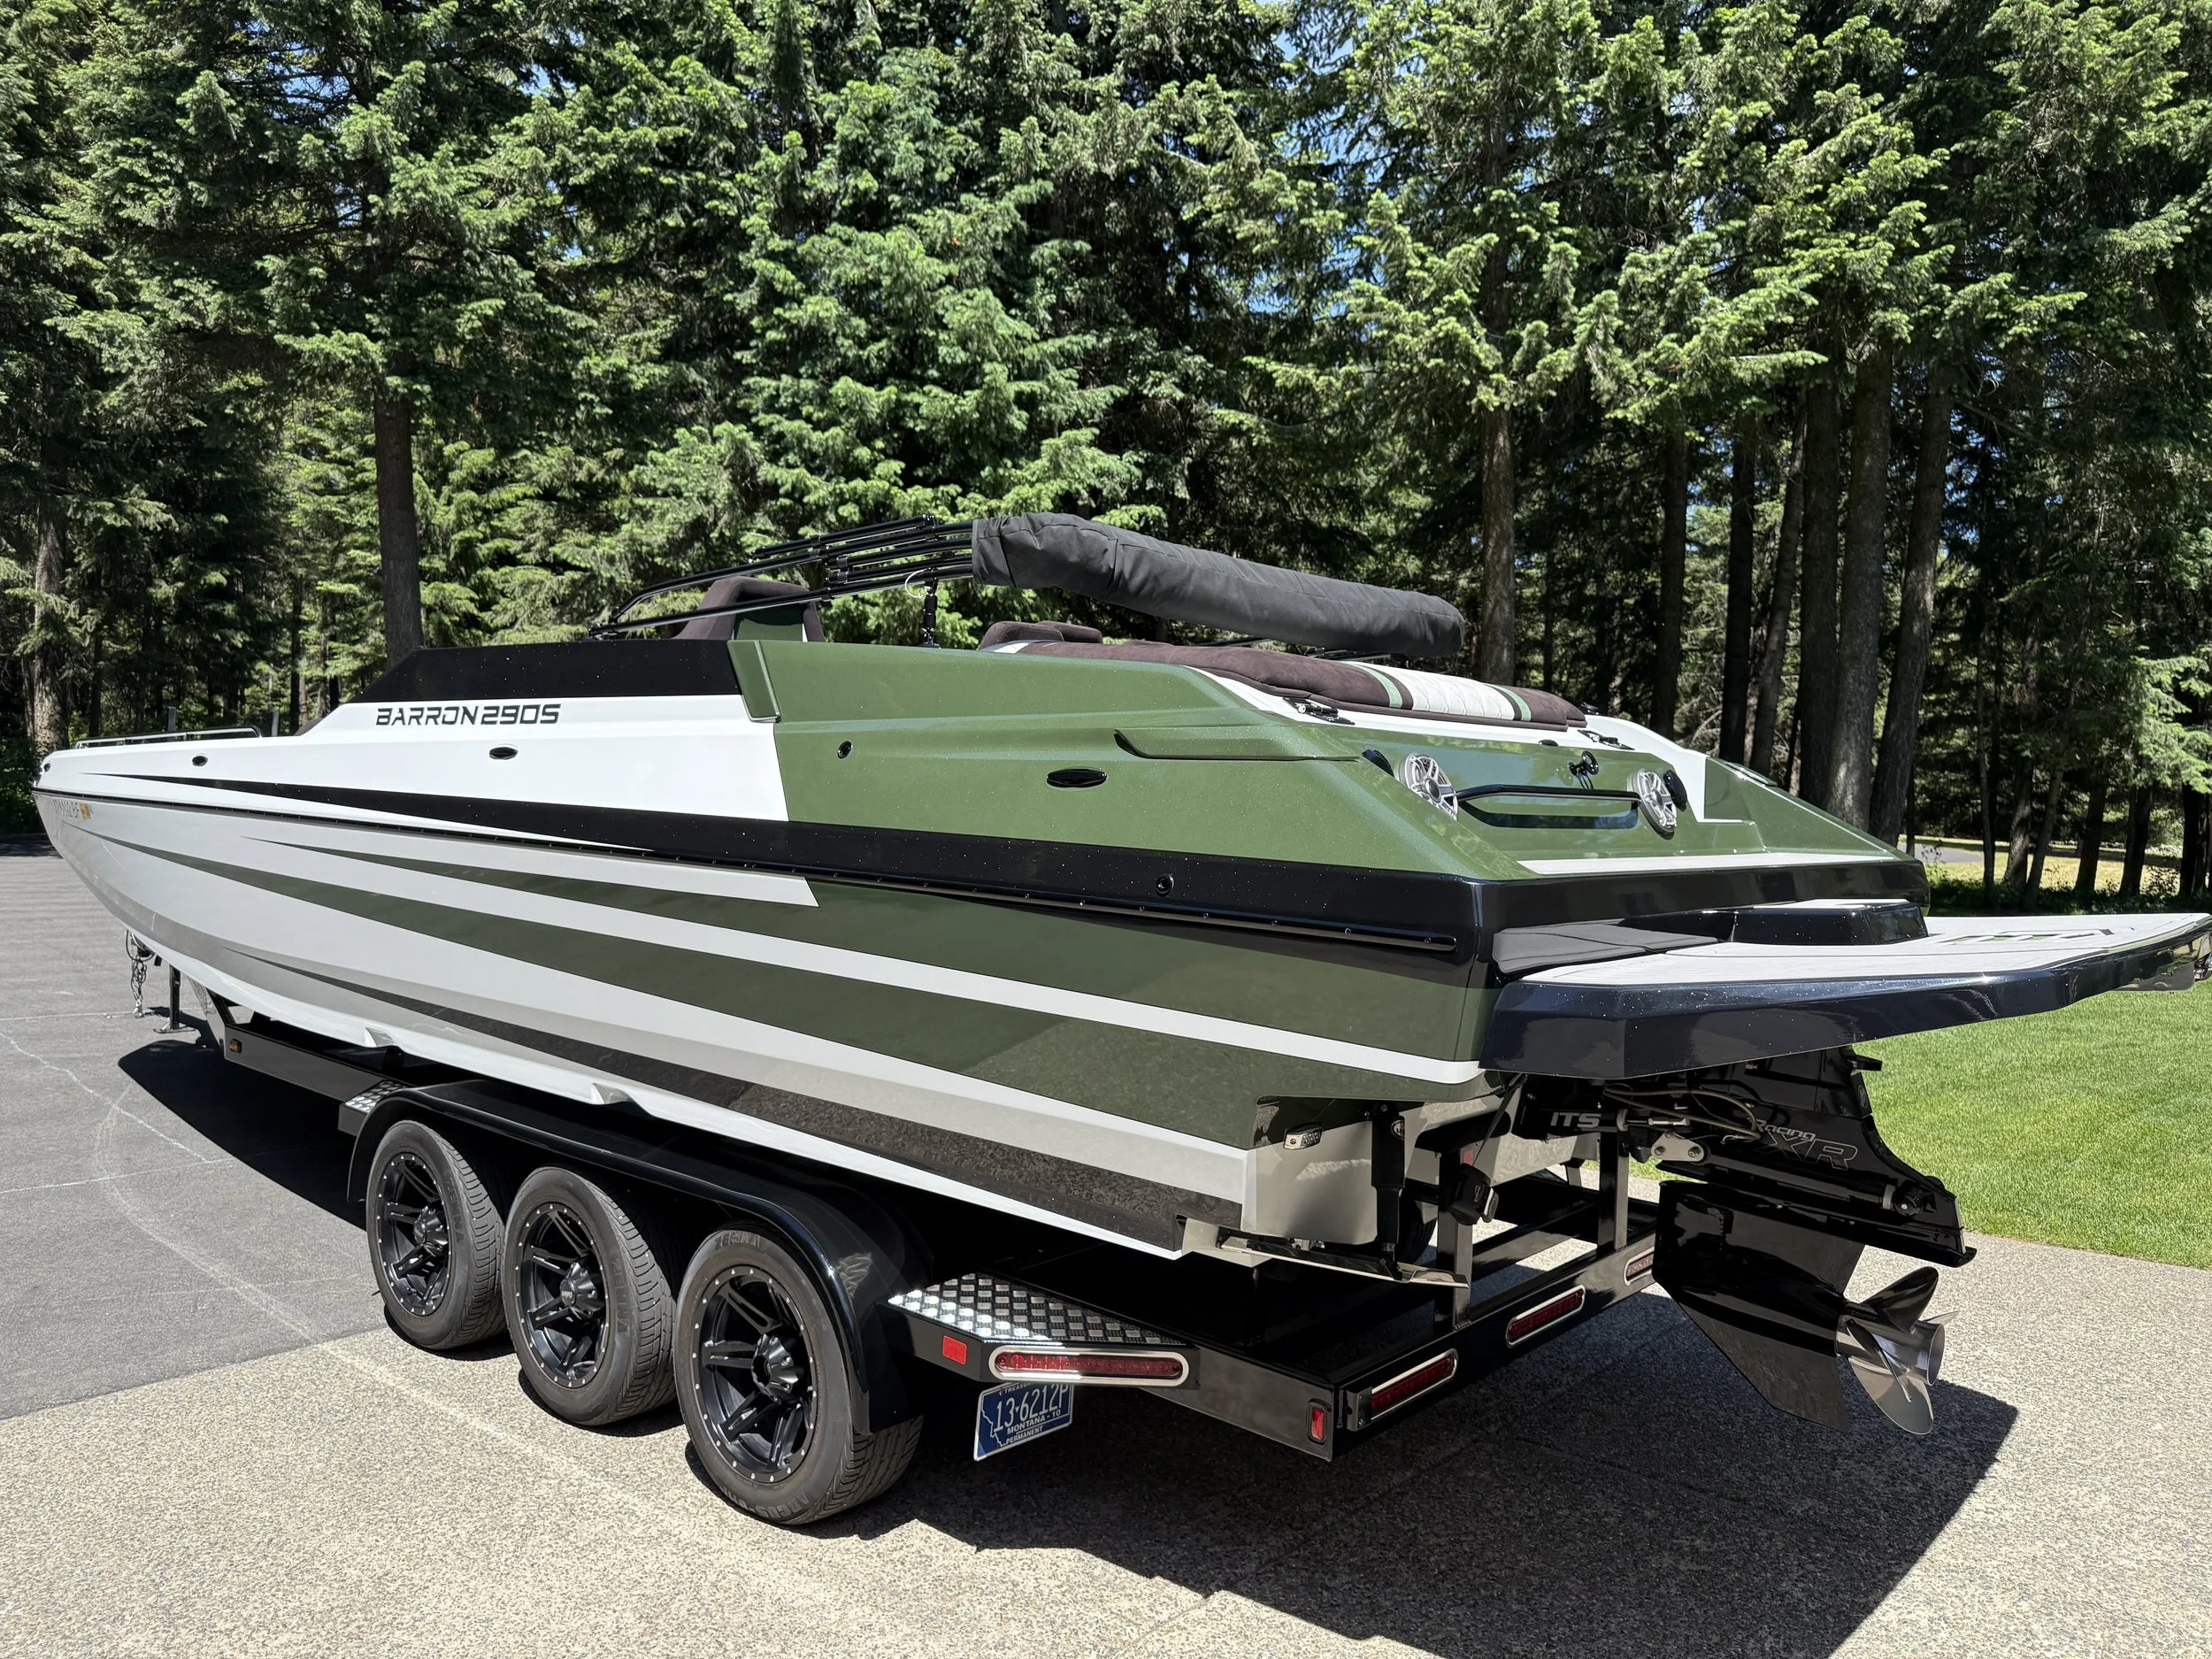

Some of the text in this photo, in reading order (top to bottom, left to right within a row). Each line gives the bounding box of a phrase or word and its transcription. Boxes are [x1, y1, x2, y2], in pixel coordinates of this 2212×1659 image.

[375, 703, 561, 726] BARRON 290S
[1550, 1111, 1601, 1128] ITS
[1747, 1118, 1816, 1142] Racing
[1759, 1132, 1858, 1171] XR
[1005, 1425, 1043, 1444] PERMANENT
[1007, 1417, 1046, 1434] MONTANA
